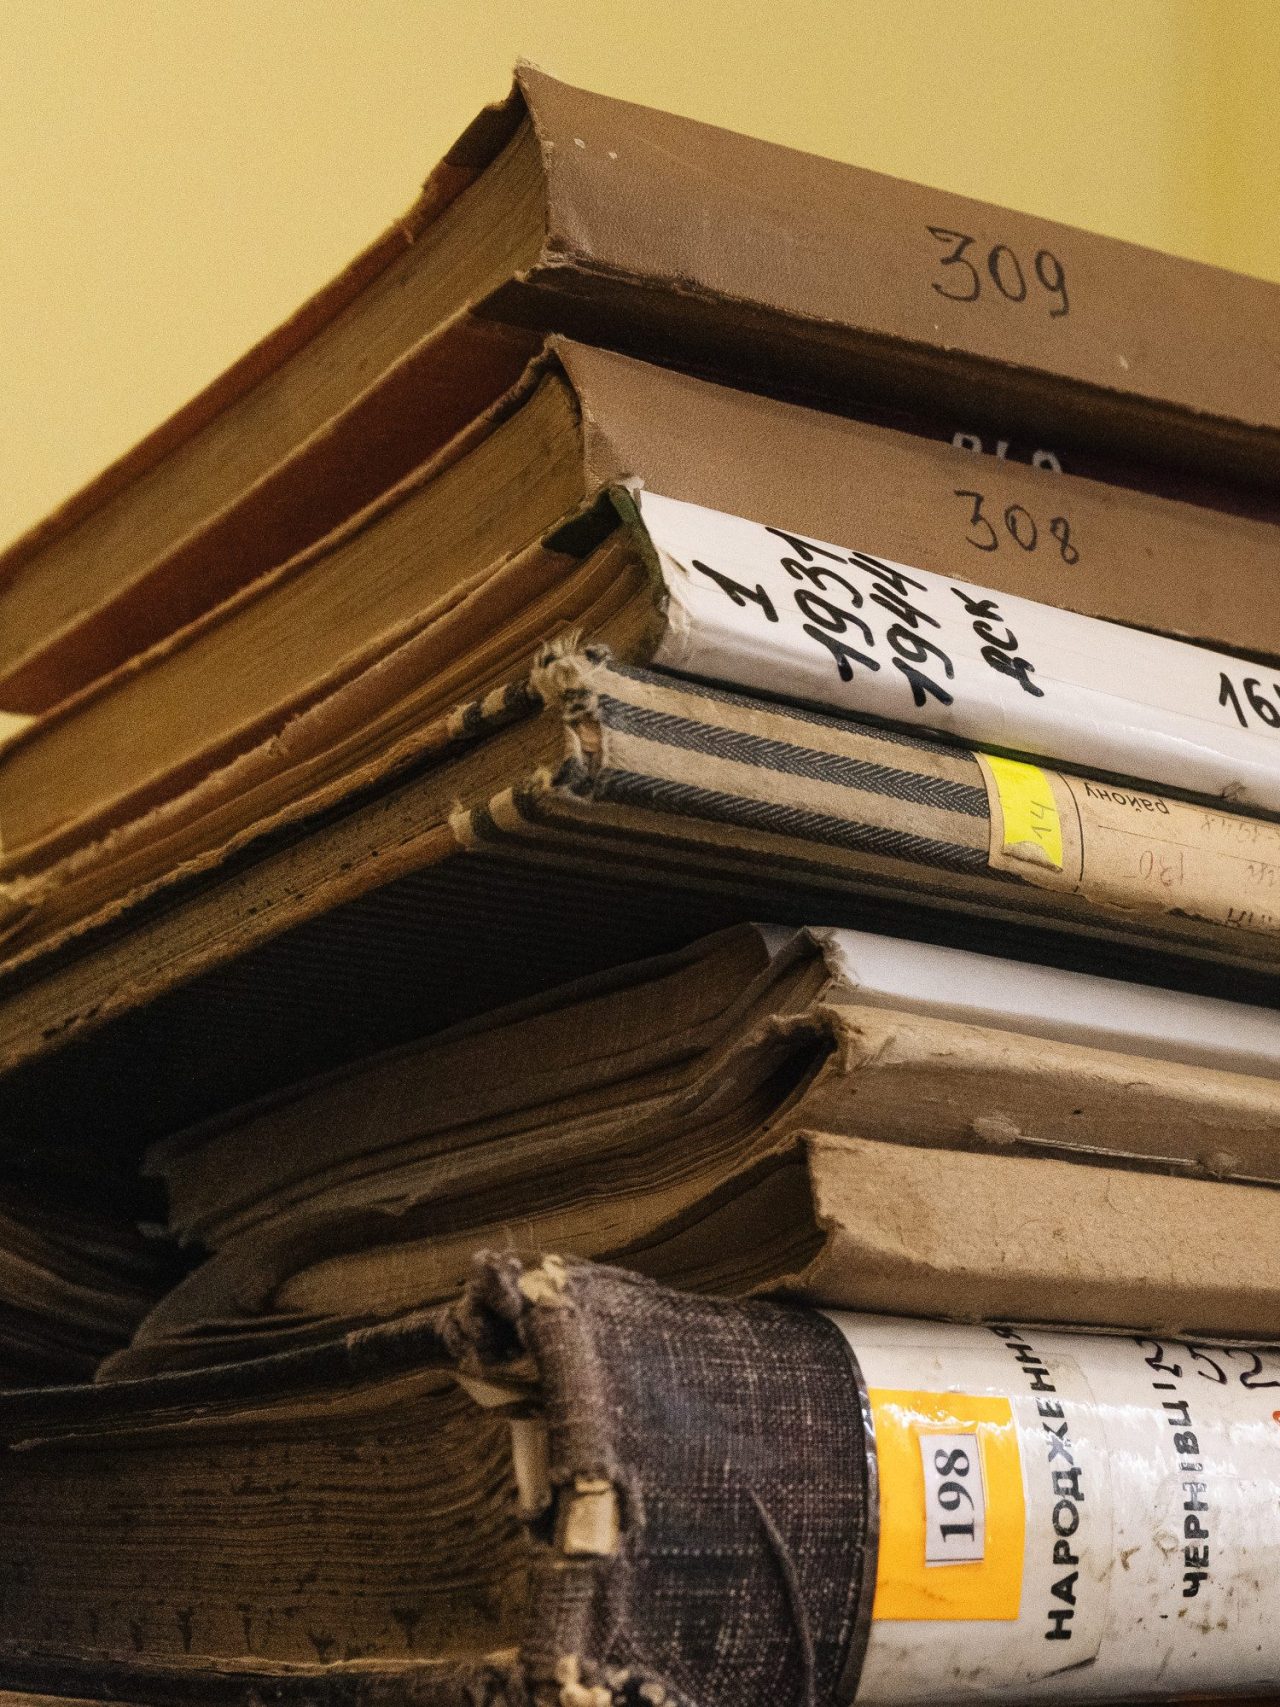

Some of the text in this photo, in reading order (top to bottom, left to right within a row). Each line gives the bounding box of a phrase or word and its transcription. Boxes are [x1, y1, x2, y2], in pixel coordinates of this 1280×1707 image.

[926, 224, 1070, 318] 309
[954, 488, 1080, 565] 308
[1030, 800, 1056, 839] 14
[1083, 781, 1170, 815] району
[934, 1447, 976, 1545] 198
[991, 1325, 1085, 1641] НАРОДЖЕННЯ
[1152, 1382, 1211, 1598] ЧЕРНІВЦІ
